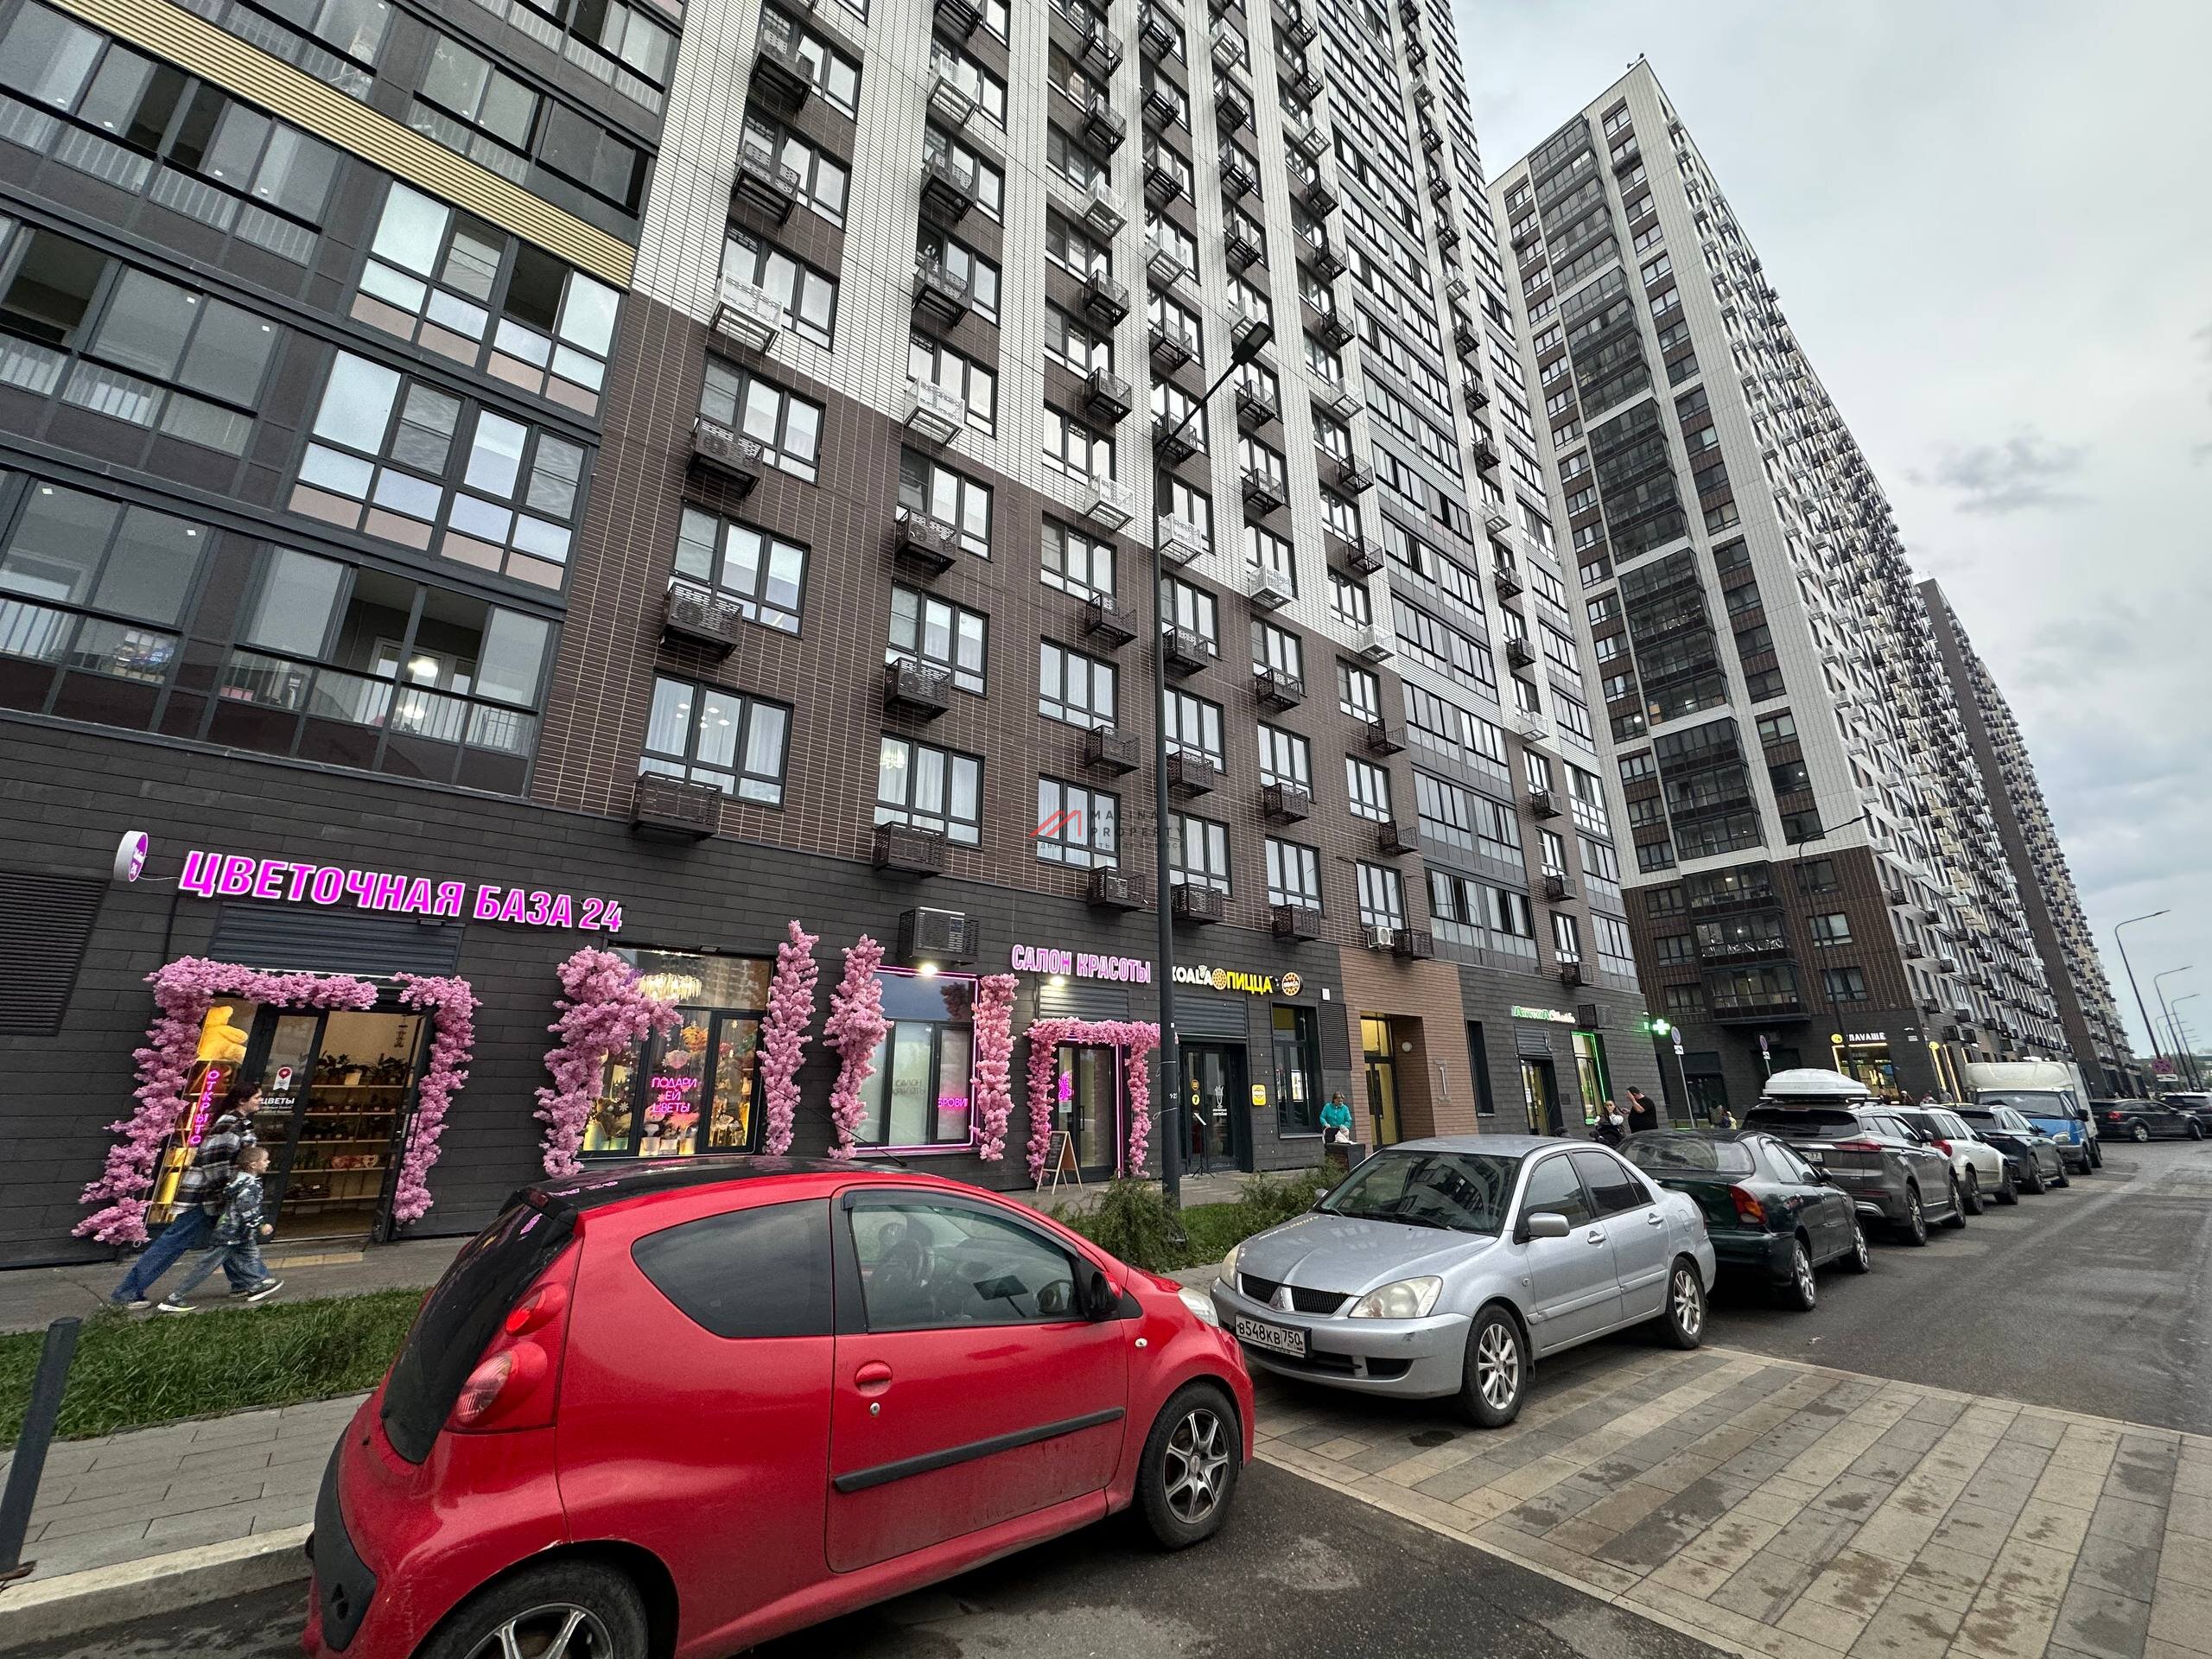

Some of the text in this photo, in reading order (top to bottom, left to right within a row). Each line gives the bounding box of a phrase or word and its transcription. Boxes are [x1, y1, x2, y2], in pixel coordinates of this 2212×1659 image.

[178, 850, 624, 933] ЦВЕТОЧНАЯ БАЗА 24
[1011, 944, 1152, 984] САЛОН КРАСОТЫ
[1226, 971, 1274, 995] ПИЦЦА
[650, 1077, 698, 1090] ПОДАРИ
[664, 1089, 682, 1101] ЕЙ
[189, 1071, 219, 1144] ОТКРЫТО
[652, 1102, 690, 1114] ЦВЕТЫ
[1238, 1320, 1300, 1345] В548КВ 750
